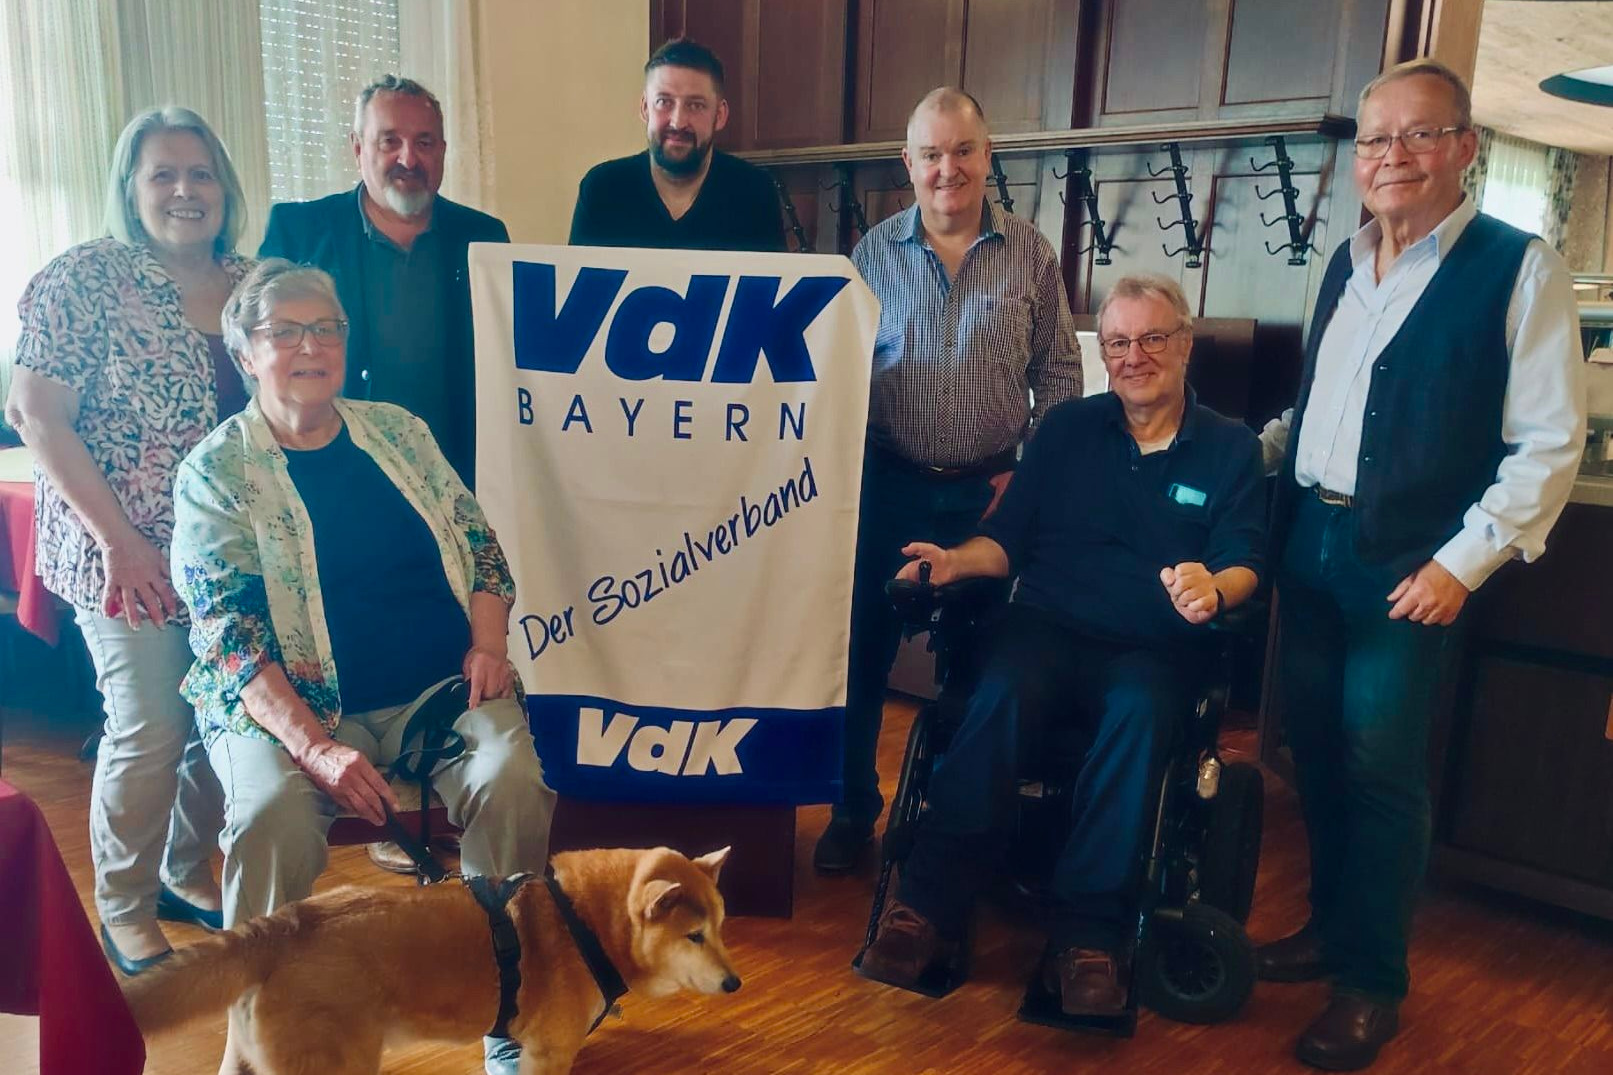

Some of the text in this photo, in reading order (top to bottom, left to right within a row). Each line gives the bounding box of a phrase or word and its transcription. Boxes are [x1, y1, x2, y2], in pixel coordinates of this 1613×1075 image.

[512, 261, 851, 383] VdK
[518, 387, 806, 441] BAYERN
[519, 457, 819, 660] Der Sozialverband
[577, 708, 758, 776] VdK
